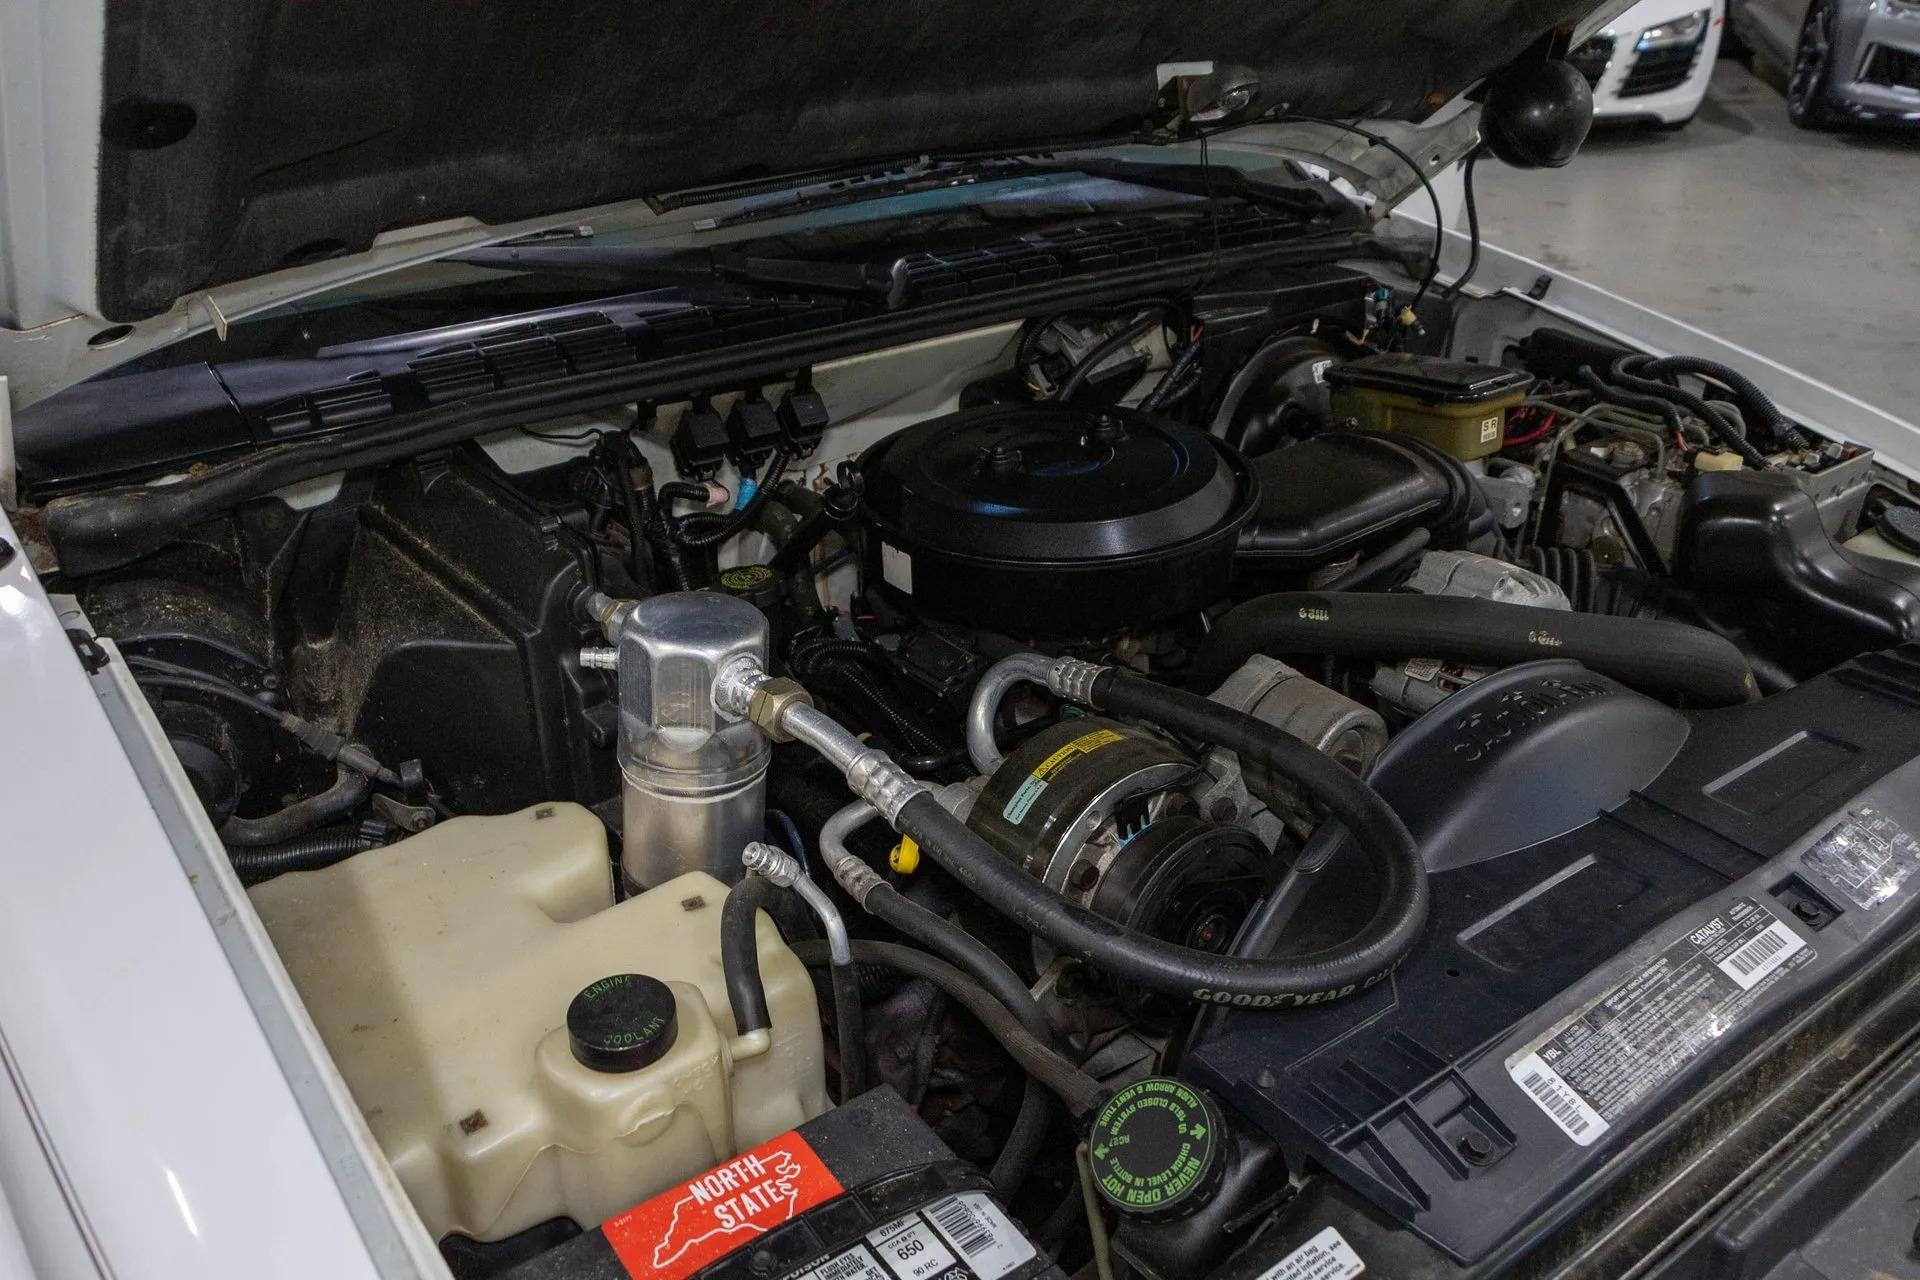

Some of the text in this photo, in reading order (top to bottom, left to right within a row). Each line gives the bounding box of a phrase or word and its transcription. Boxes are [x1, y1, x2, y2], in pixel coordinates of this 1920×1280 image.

[1690, 918, 1724, 944] CATALYST
[603, 1016, 665, 1045] COOLANT
[1543, 1047, 1562, 1061] YBL
[1115, 1090, 1137, 1108] VENT
[1145, 1082, 1177, 1094] ARROW
[1176, 1087, 1198, 1109] ALIGN
[1136, 1097, 1169, 1109] CLOSED
[1099, 1105, 1117, 1128] TUBE
[1110, 1104, 1137, 1136] SYSTEM
[1109, 1142, 1191, 1187] CHECK LEVEL IN BOTTLE
[688, 1154, 767, 1206] NORTH
[1102, 1156, 1200, 1204] NEVER OPEN HOT
[879, 1219, 906, 1237] 675MF
[887, 1239, 900, 1250] CCA
[897, 1239, 924, 1260] 650
[820, 1253, 855, 1275] FLUSH EYES
[912, 1258, 939, 1277] 90 RC
[1285, 1260, 1296, 1271] an
[1294, 1253, 1304, 1265] air
[1303, 1245, 1319, 1257] bag
[1313, 1256, 1337, 1275] service
